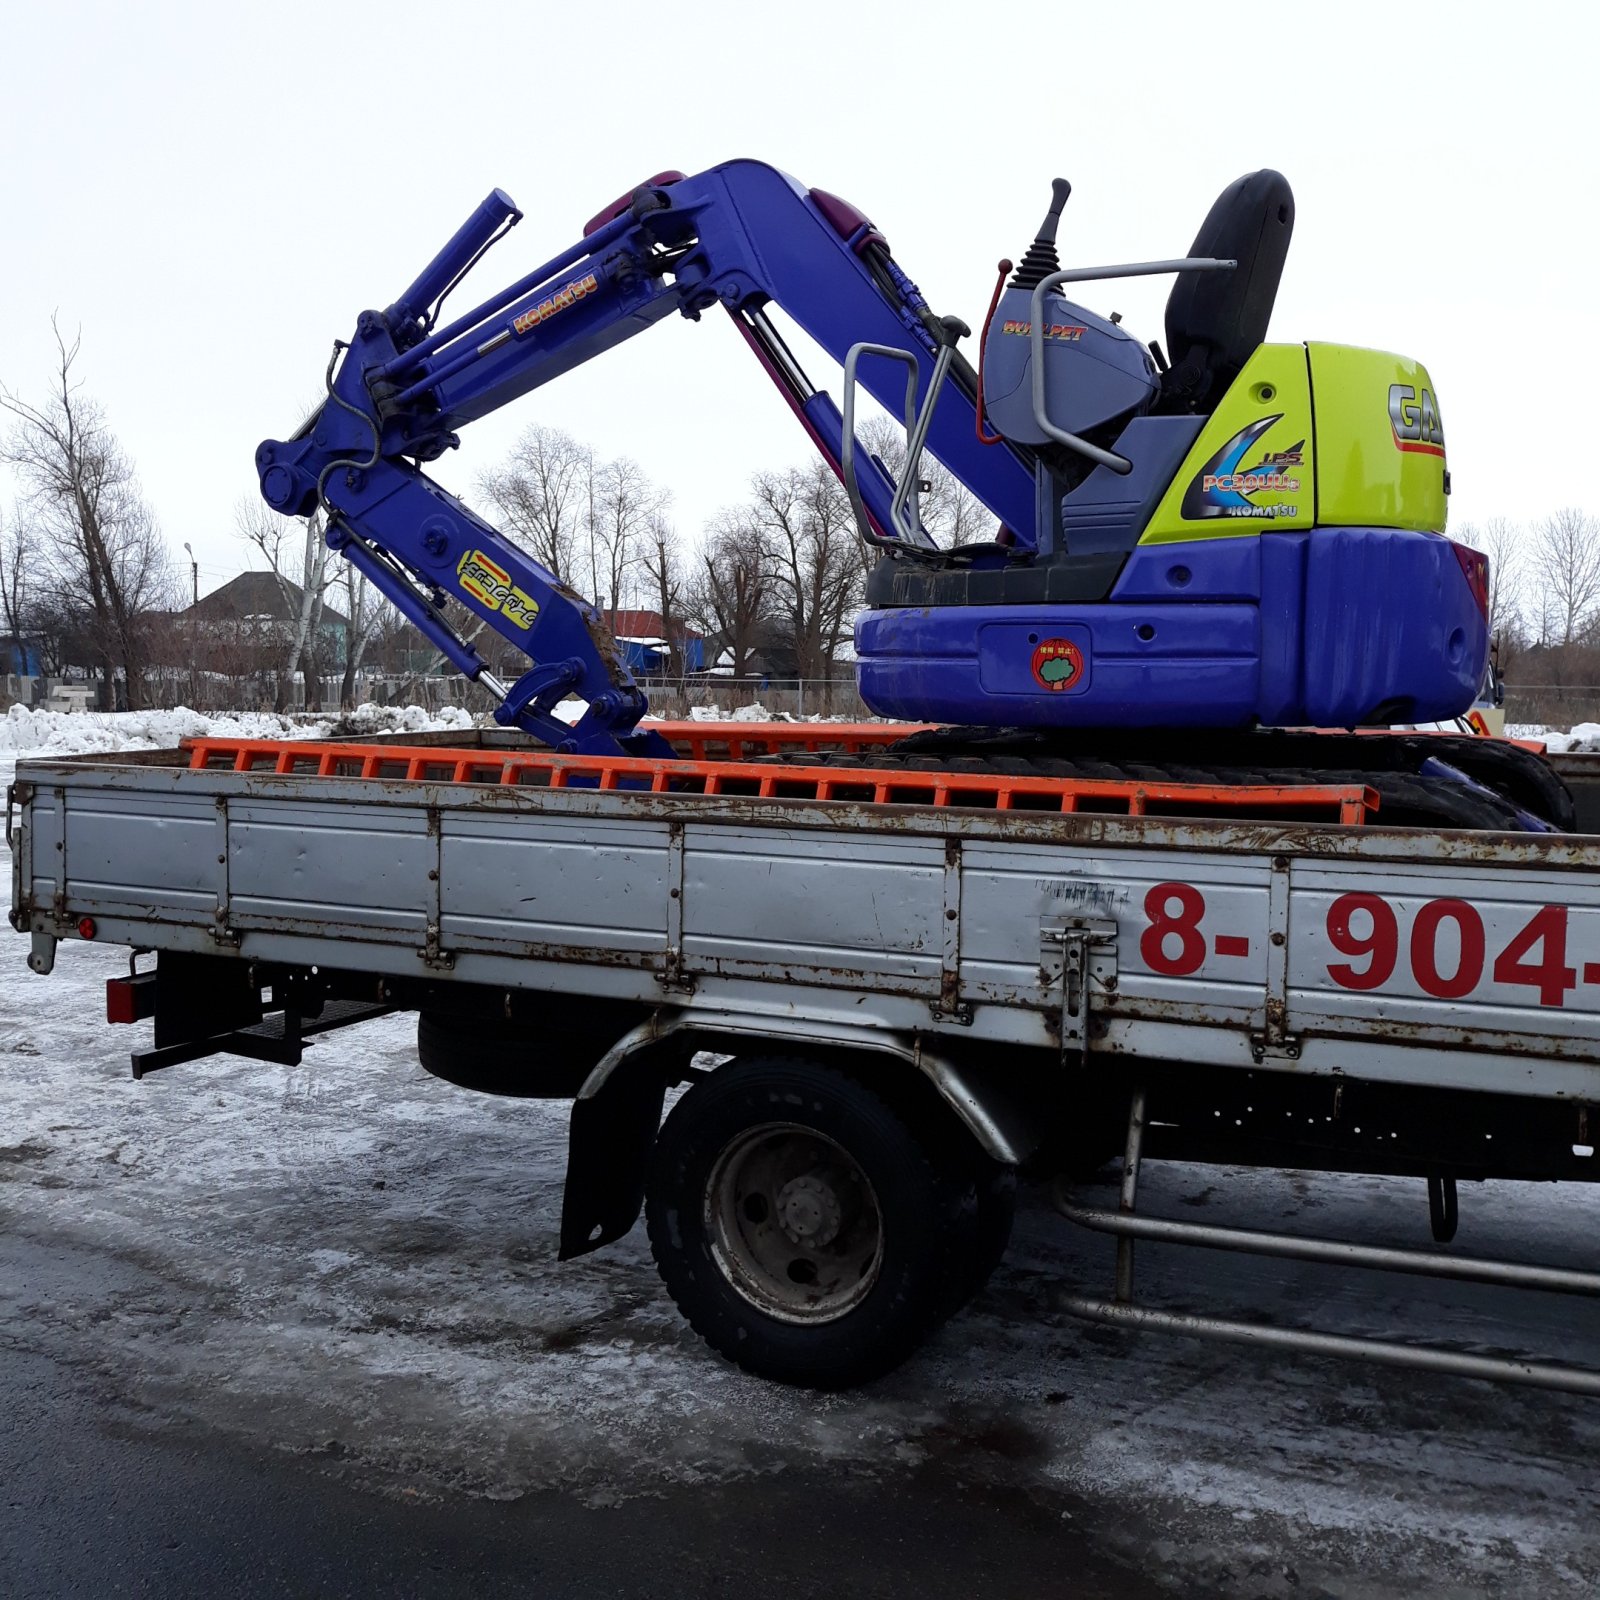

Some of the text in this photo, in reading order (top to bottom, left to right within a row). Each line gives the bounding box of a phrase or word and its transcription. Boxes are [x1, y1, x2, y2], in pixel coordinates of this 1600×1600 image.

[513, 273, 598, 335] KOMATSU
[1002, 320, 1088, 341] BULPET
[1231, 503, 1297, 517] KOMATSU
[1140, 882, 1249, 976] 8-
